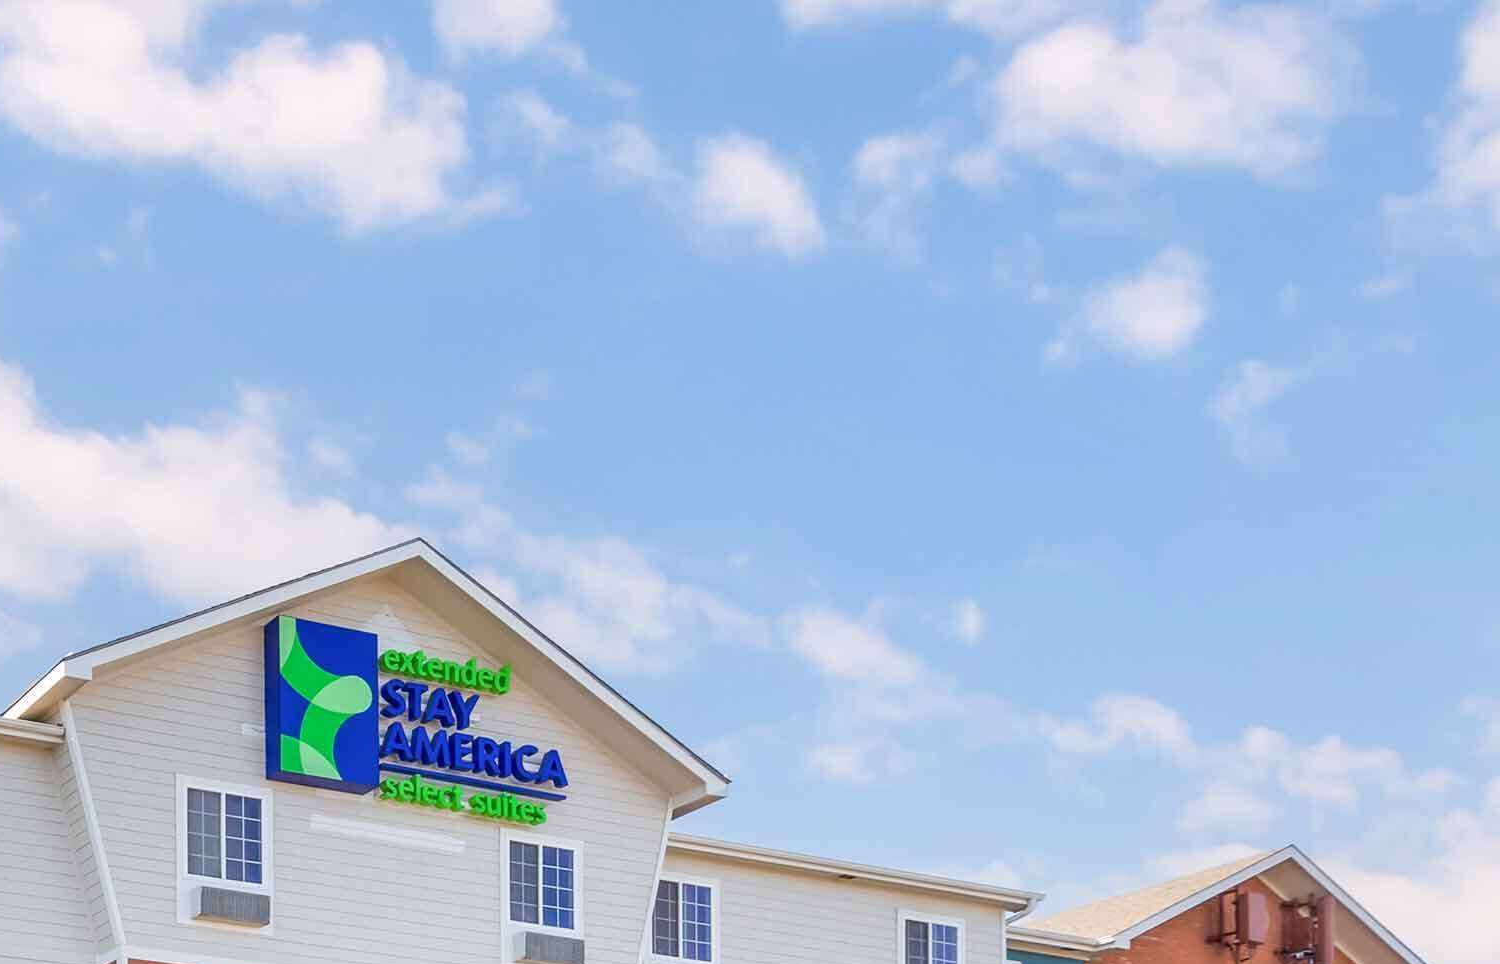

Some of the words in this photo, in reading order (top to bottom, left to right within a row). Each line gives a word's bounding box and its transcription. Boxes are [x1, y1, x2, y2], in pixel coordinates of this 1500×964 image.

[379, 649, 512, 695] extended
[380, 678, 480, 731] STAY
[379, 721, 569, 788] AMERICA
[380, 774, 465, 811] select
[468, 792, 547, 825] suites
